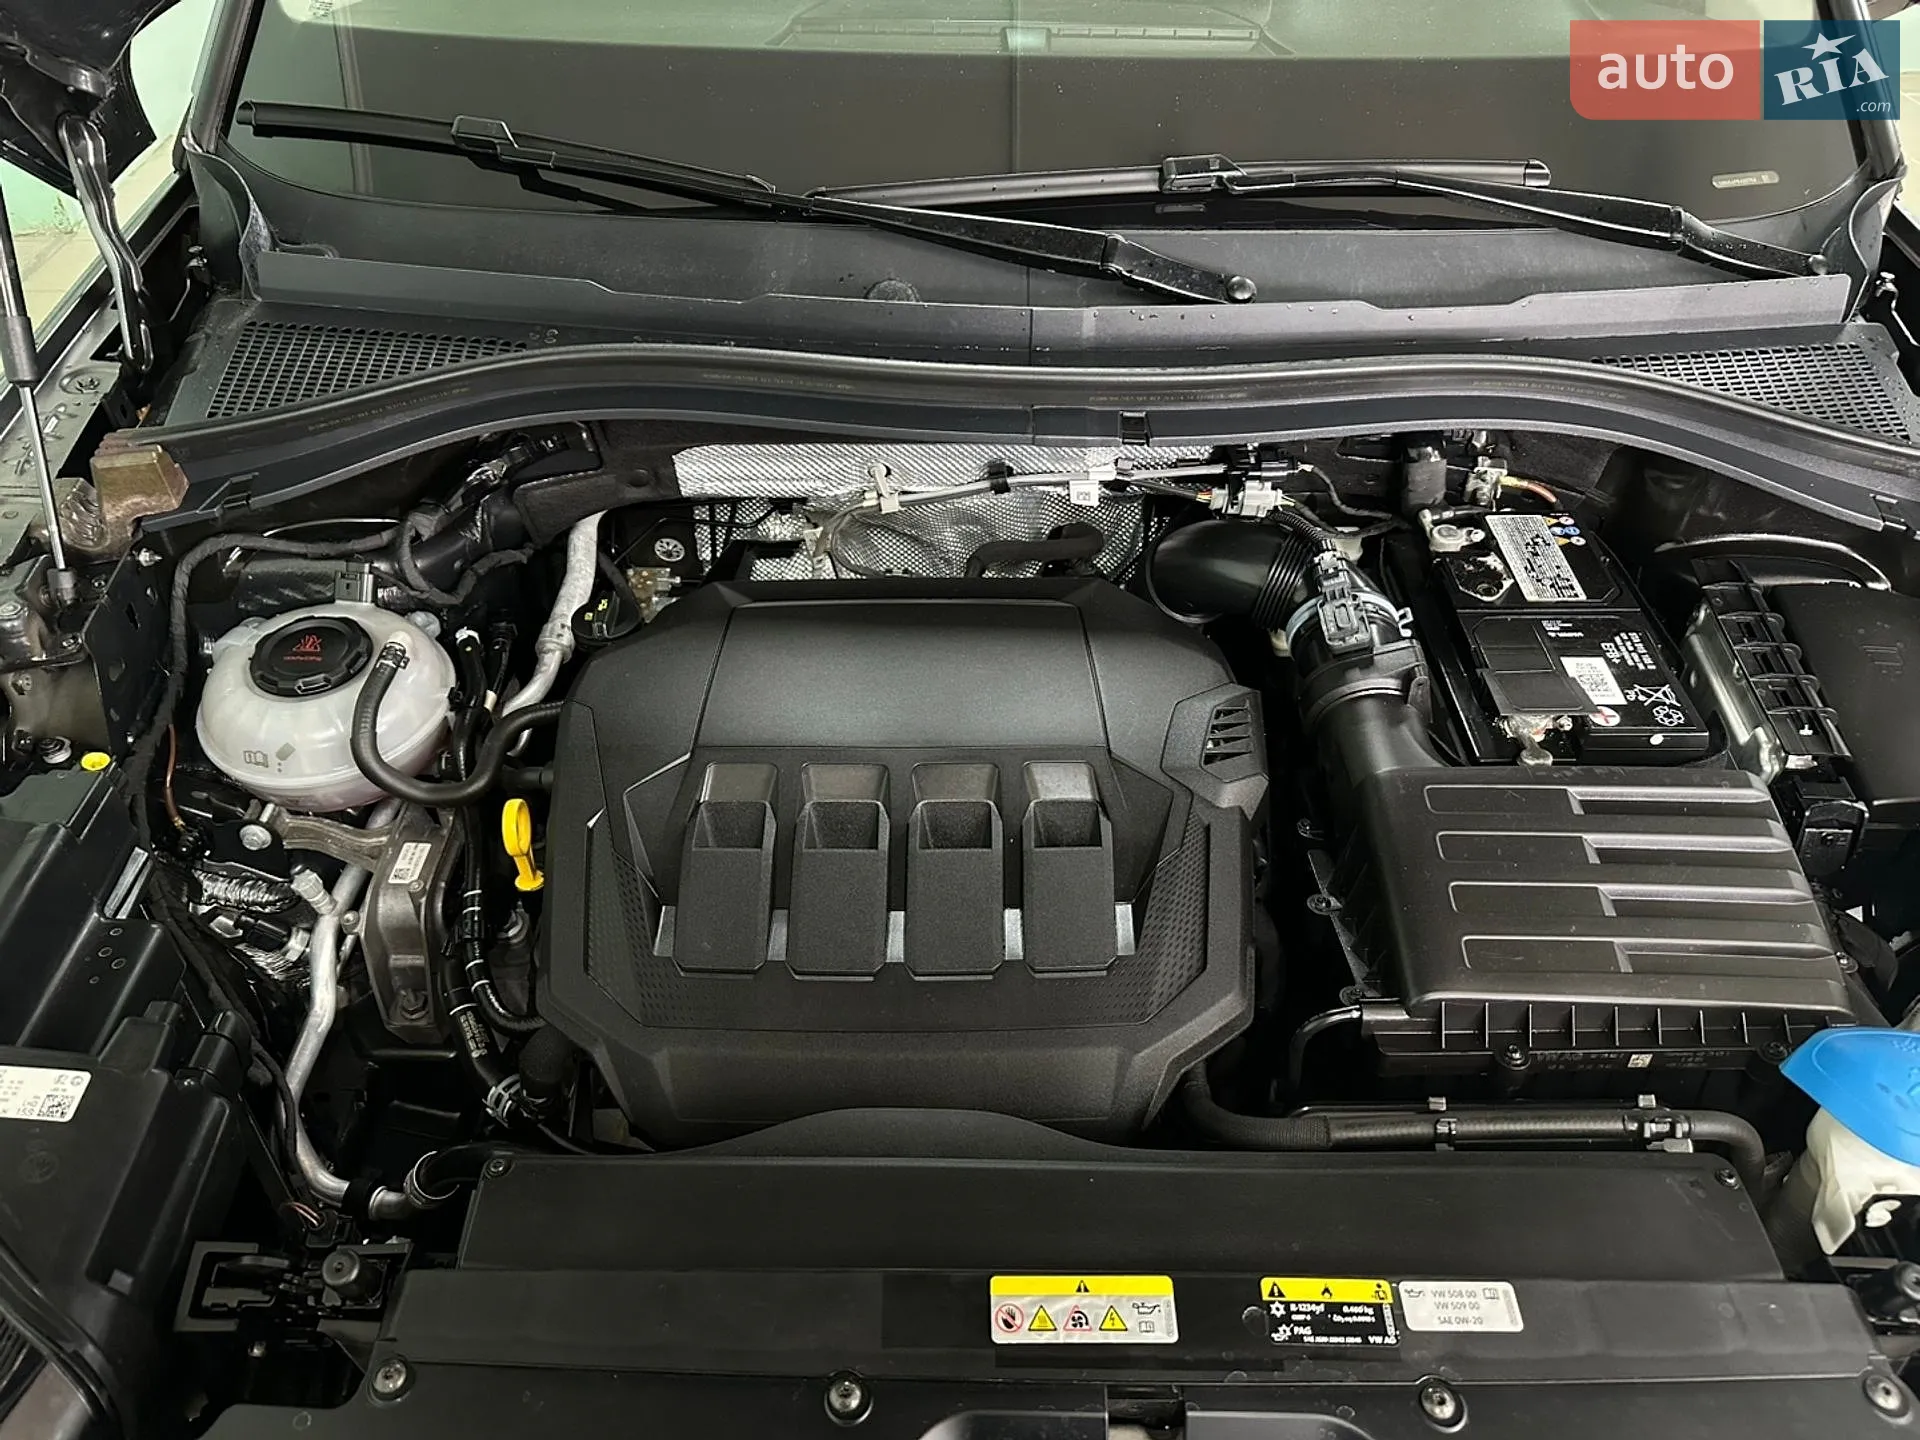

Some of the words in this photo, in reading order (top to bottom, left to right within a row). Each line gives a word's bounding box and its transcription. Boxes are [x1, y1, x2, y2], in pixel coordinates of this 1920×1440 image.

[1430, 1289, 1446, 1298] VW
[1447, 1289, 1465, 1298] 508
[1465, 1289, 1477, 1298] 00
[1434, 1302, 1449, 1310] VW
[1450, 1302, 1467, 1310] 509
[1468, 1302, 1480, 1310] 00
[1437, 1316, 1454, 1325] SAE
[1454, 1316, 1484, 1325] 0W-20
[1293, 1325, 1312, 1335] PAG
[1367, 1335, 1383, 1344] VW
